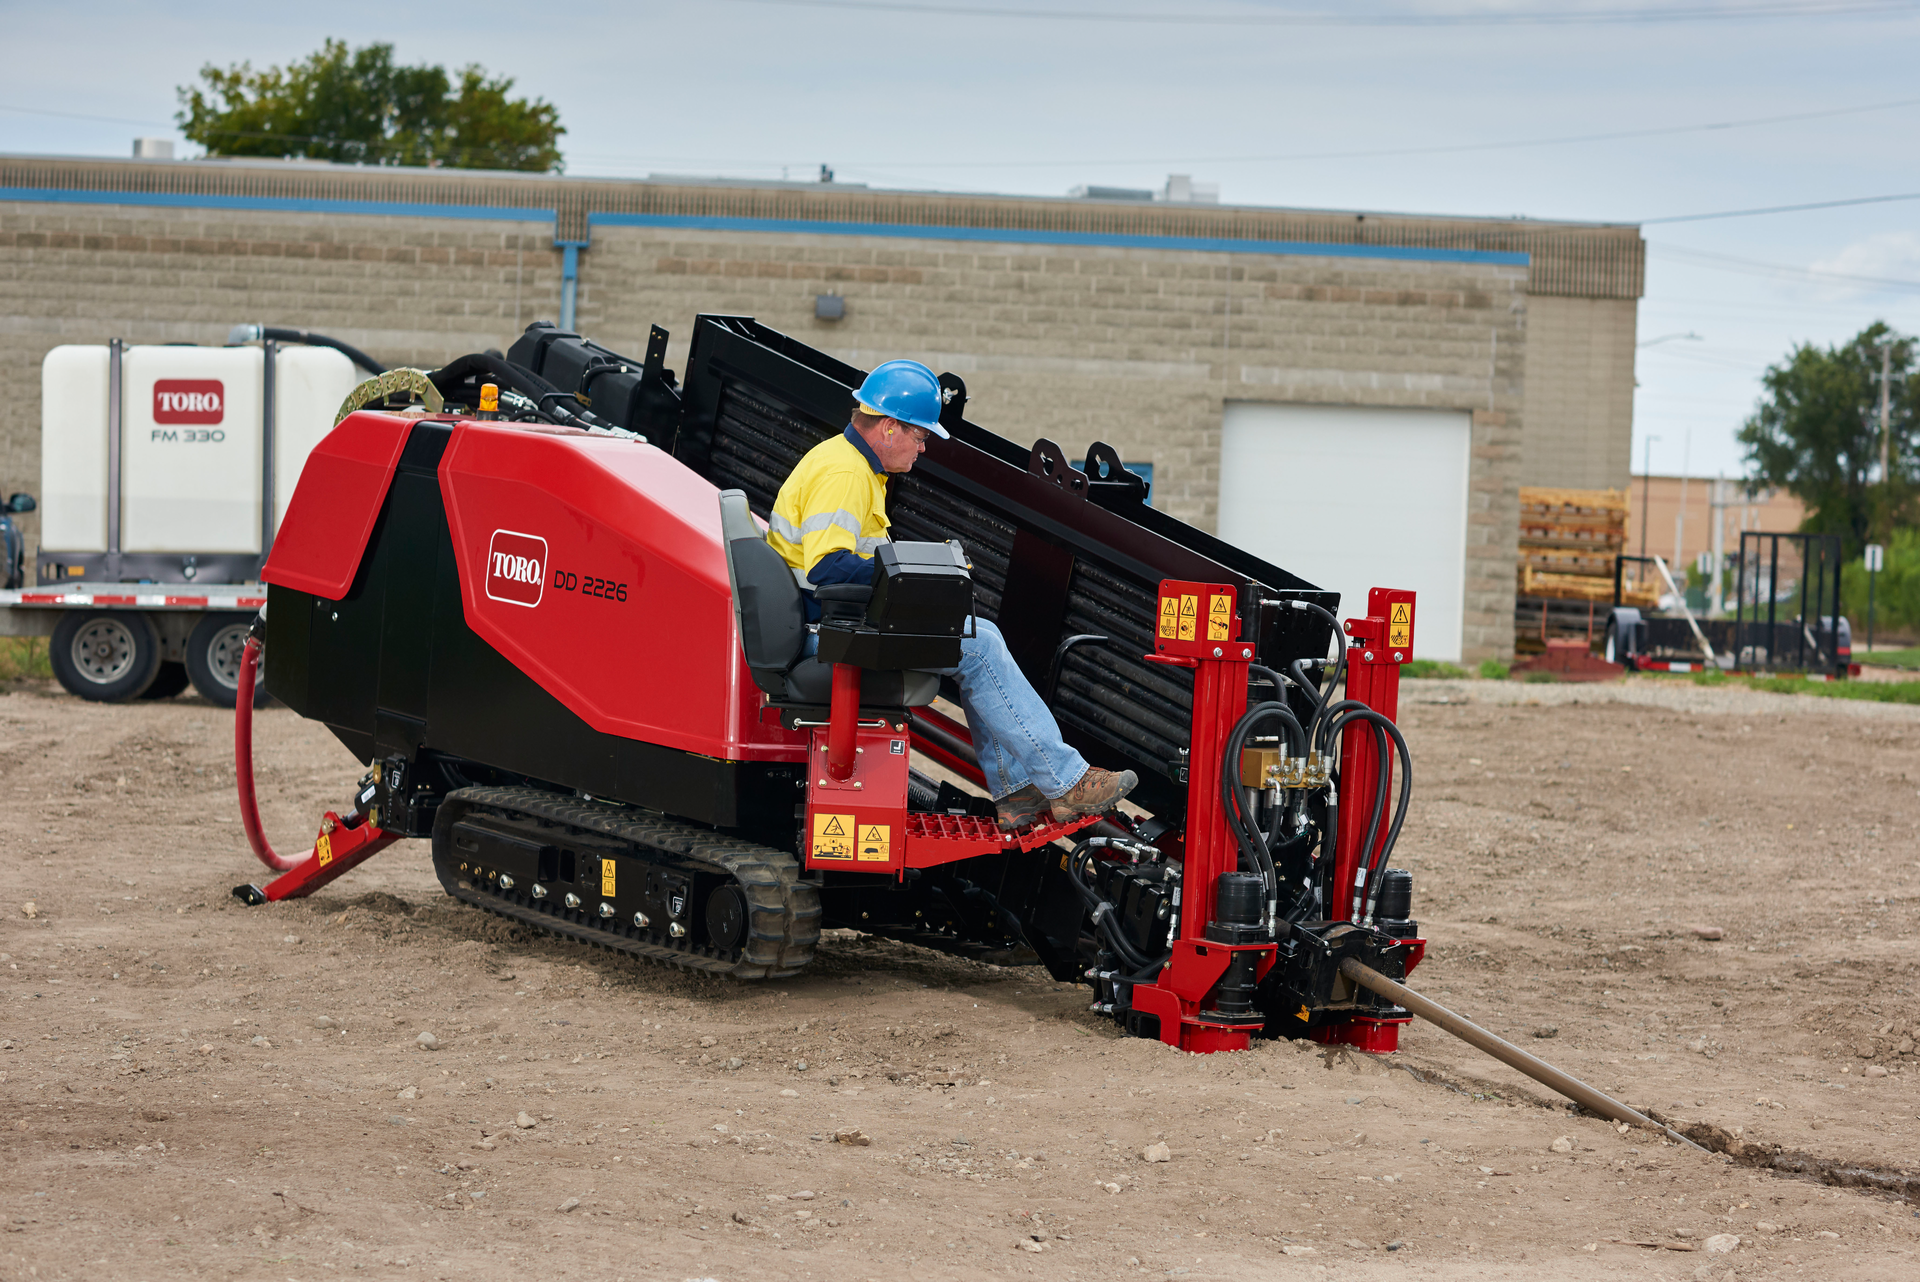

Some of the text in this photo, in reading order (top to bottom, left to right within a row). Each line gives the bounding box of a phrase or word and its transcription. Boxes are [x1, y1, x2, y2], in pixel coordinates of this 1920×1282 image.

[151, 429, 225, 442] FM 330
[553, 570, 627, 602] DD 2226
